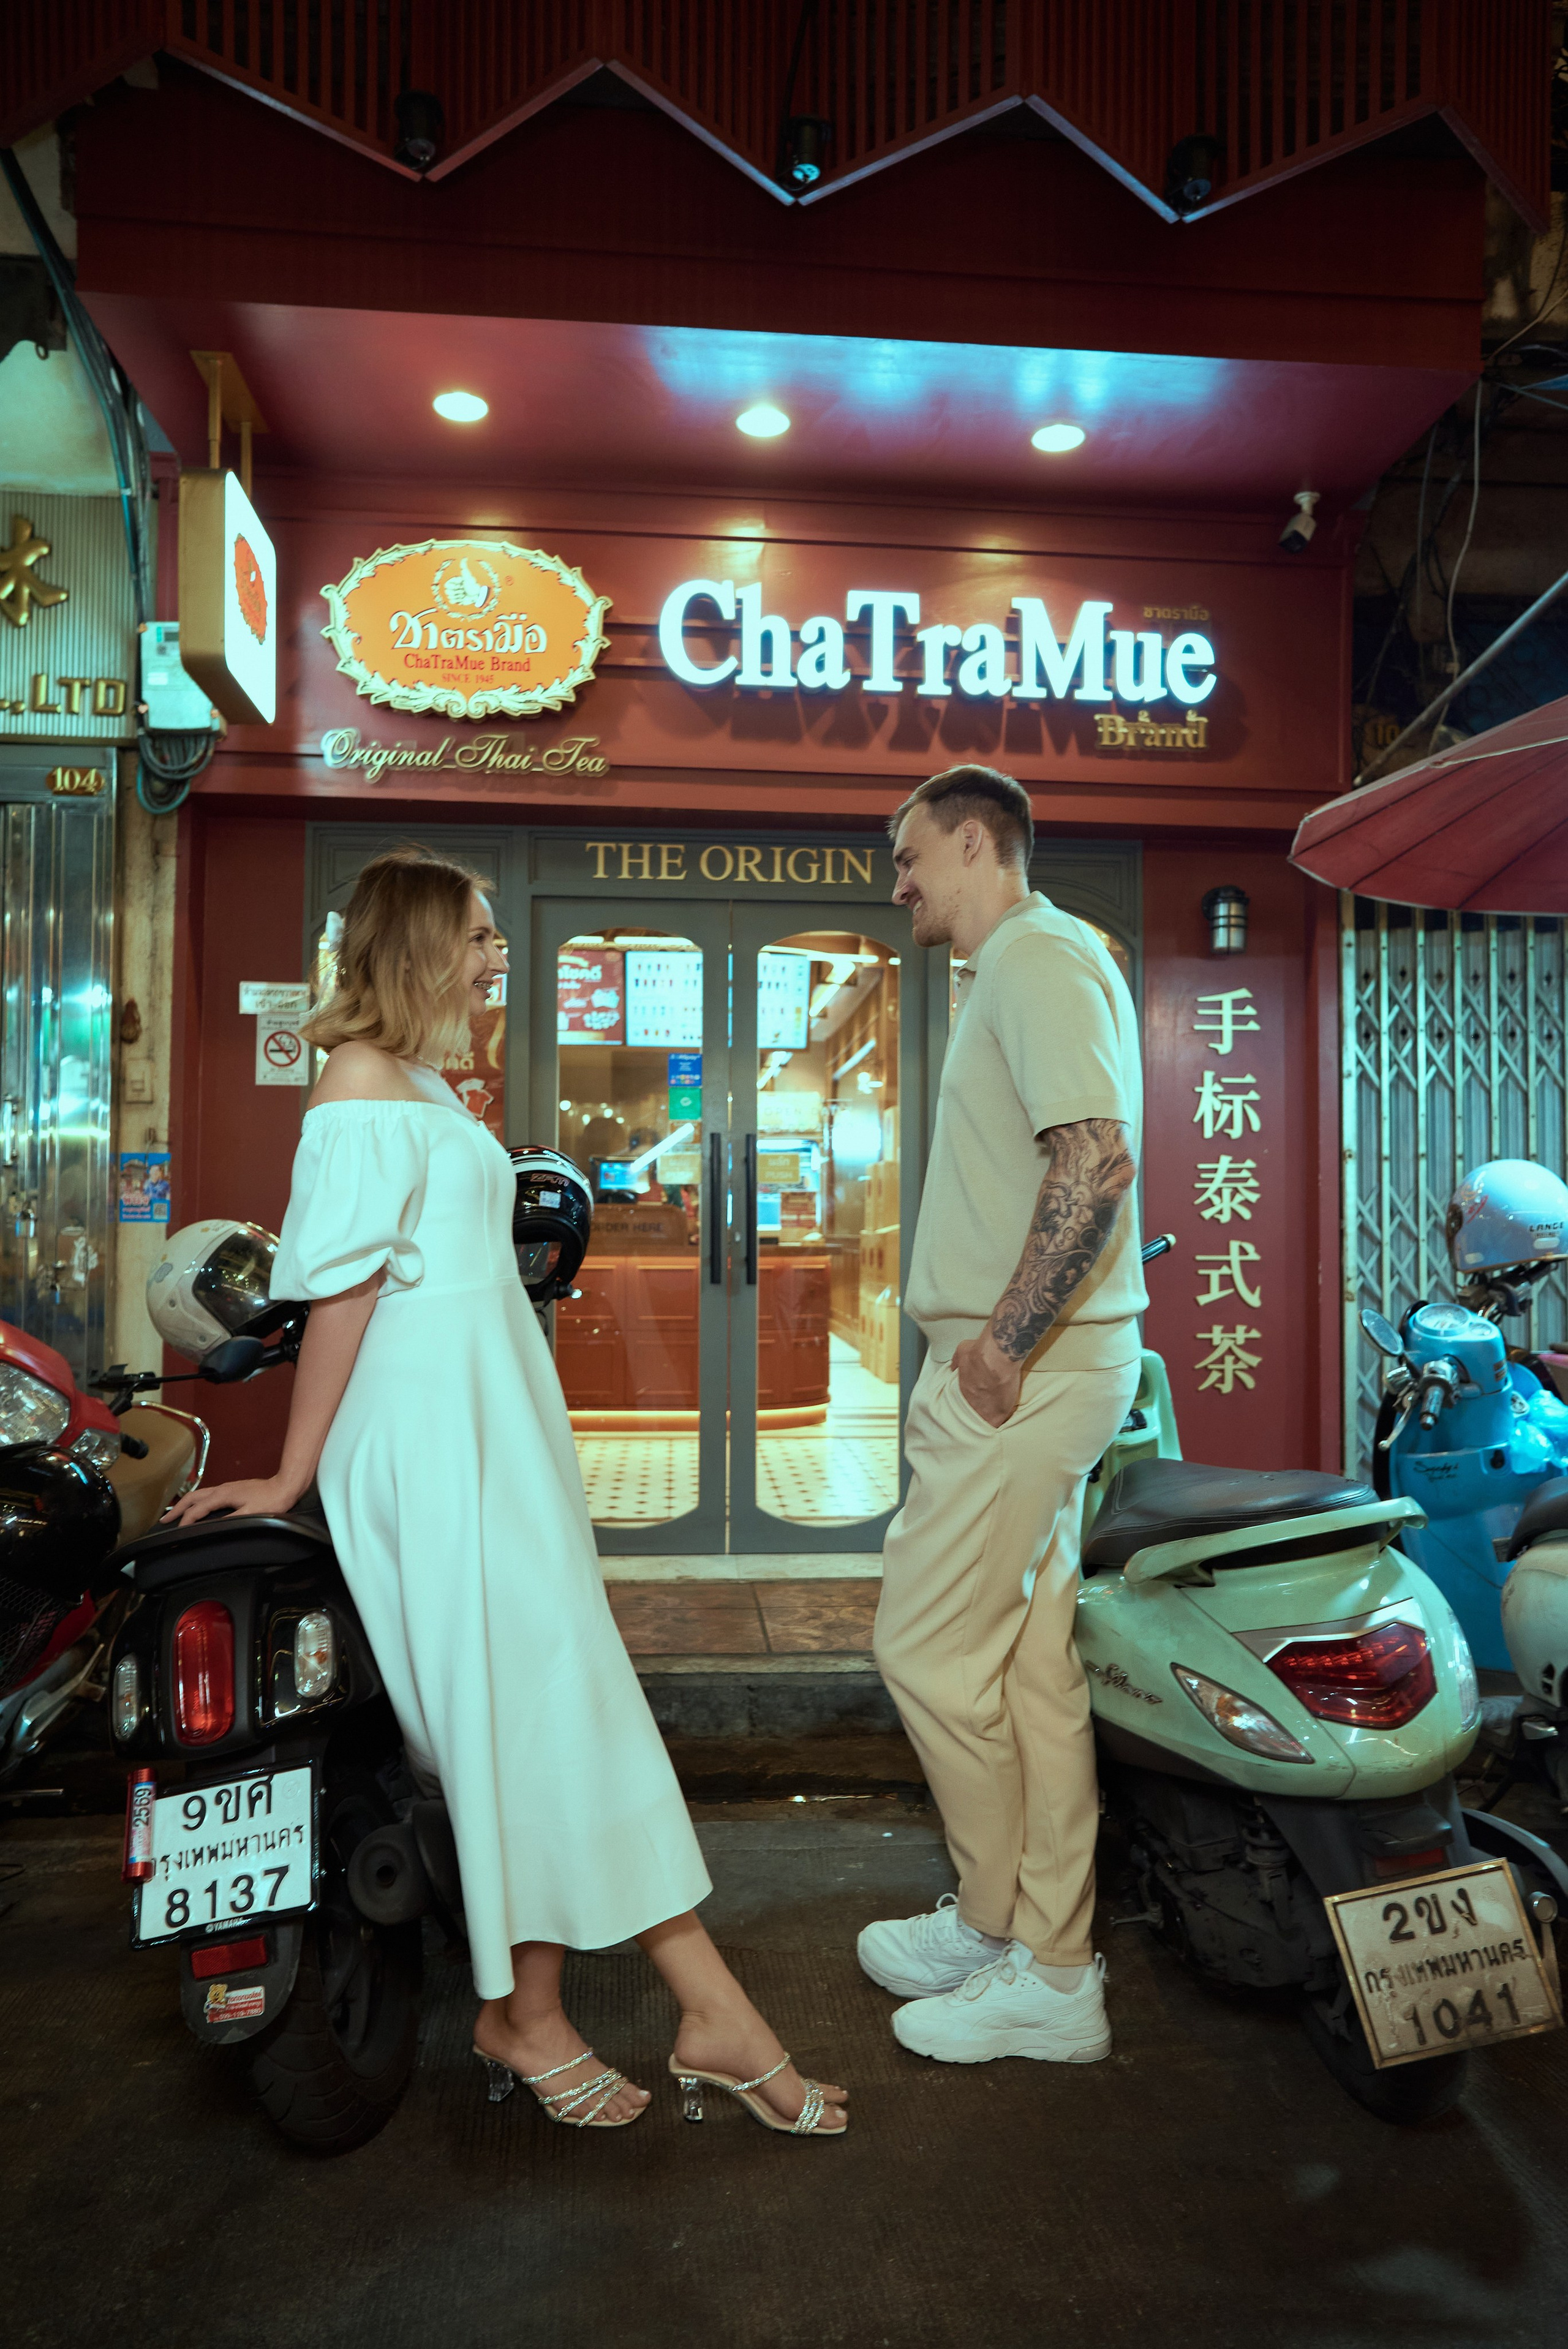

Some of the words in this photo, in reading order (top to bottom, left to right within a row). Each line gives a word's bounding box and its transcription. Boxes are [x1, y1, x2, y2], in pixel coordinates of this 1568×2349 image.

[390, 607, 547, 654] ชาตรามือ
[659, 579, 1217, 704] ChaTraMue
[404, 654, 485, 671] ChaTraMue
[491, 655, 530, 672] Brand
[442, 673, 471, 684] SINCE
[476, 674, 494, 684] 1945
[1094, 709, 1208, 748] Brand
[322, 729, 450, 783] Original
[456, 734, 533, 773] Thai
[542, 737, 609, 776] Tea
[52, 767, 98, 793] 104
[586, 842, 687, 880] THE
[699, 845, 876, 884] ORIGIN
[1193, 987, 1262, 1395] 手标泰式茶
[134, 1788, 151, 1828] 2569
[165, 1864, 290, 1928] 8137
[1404, 1983, 1521, 2046] 1041
